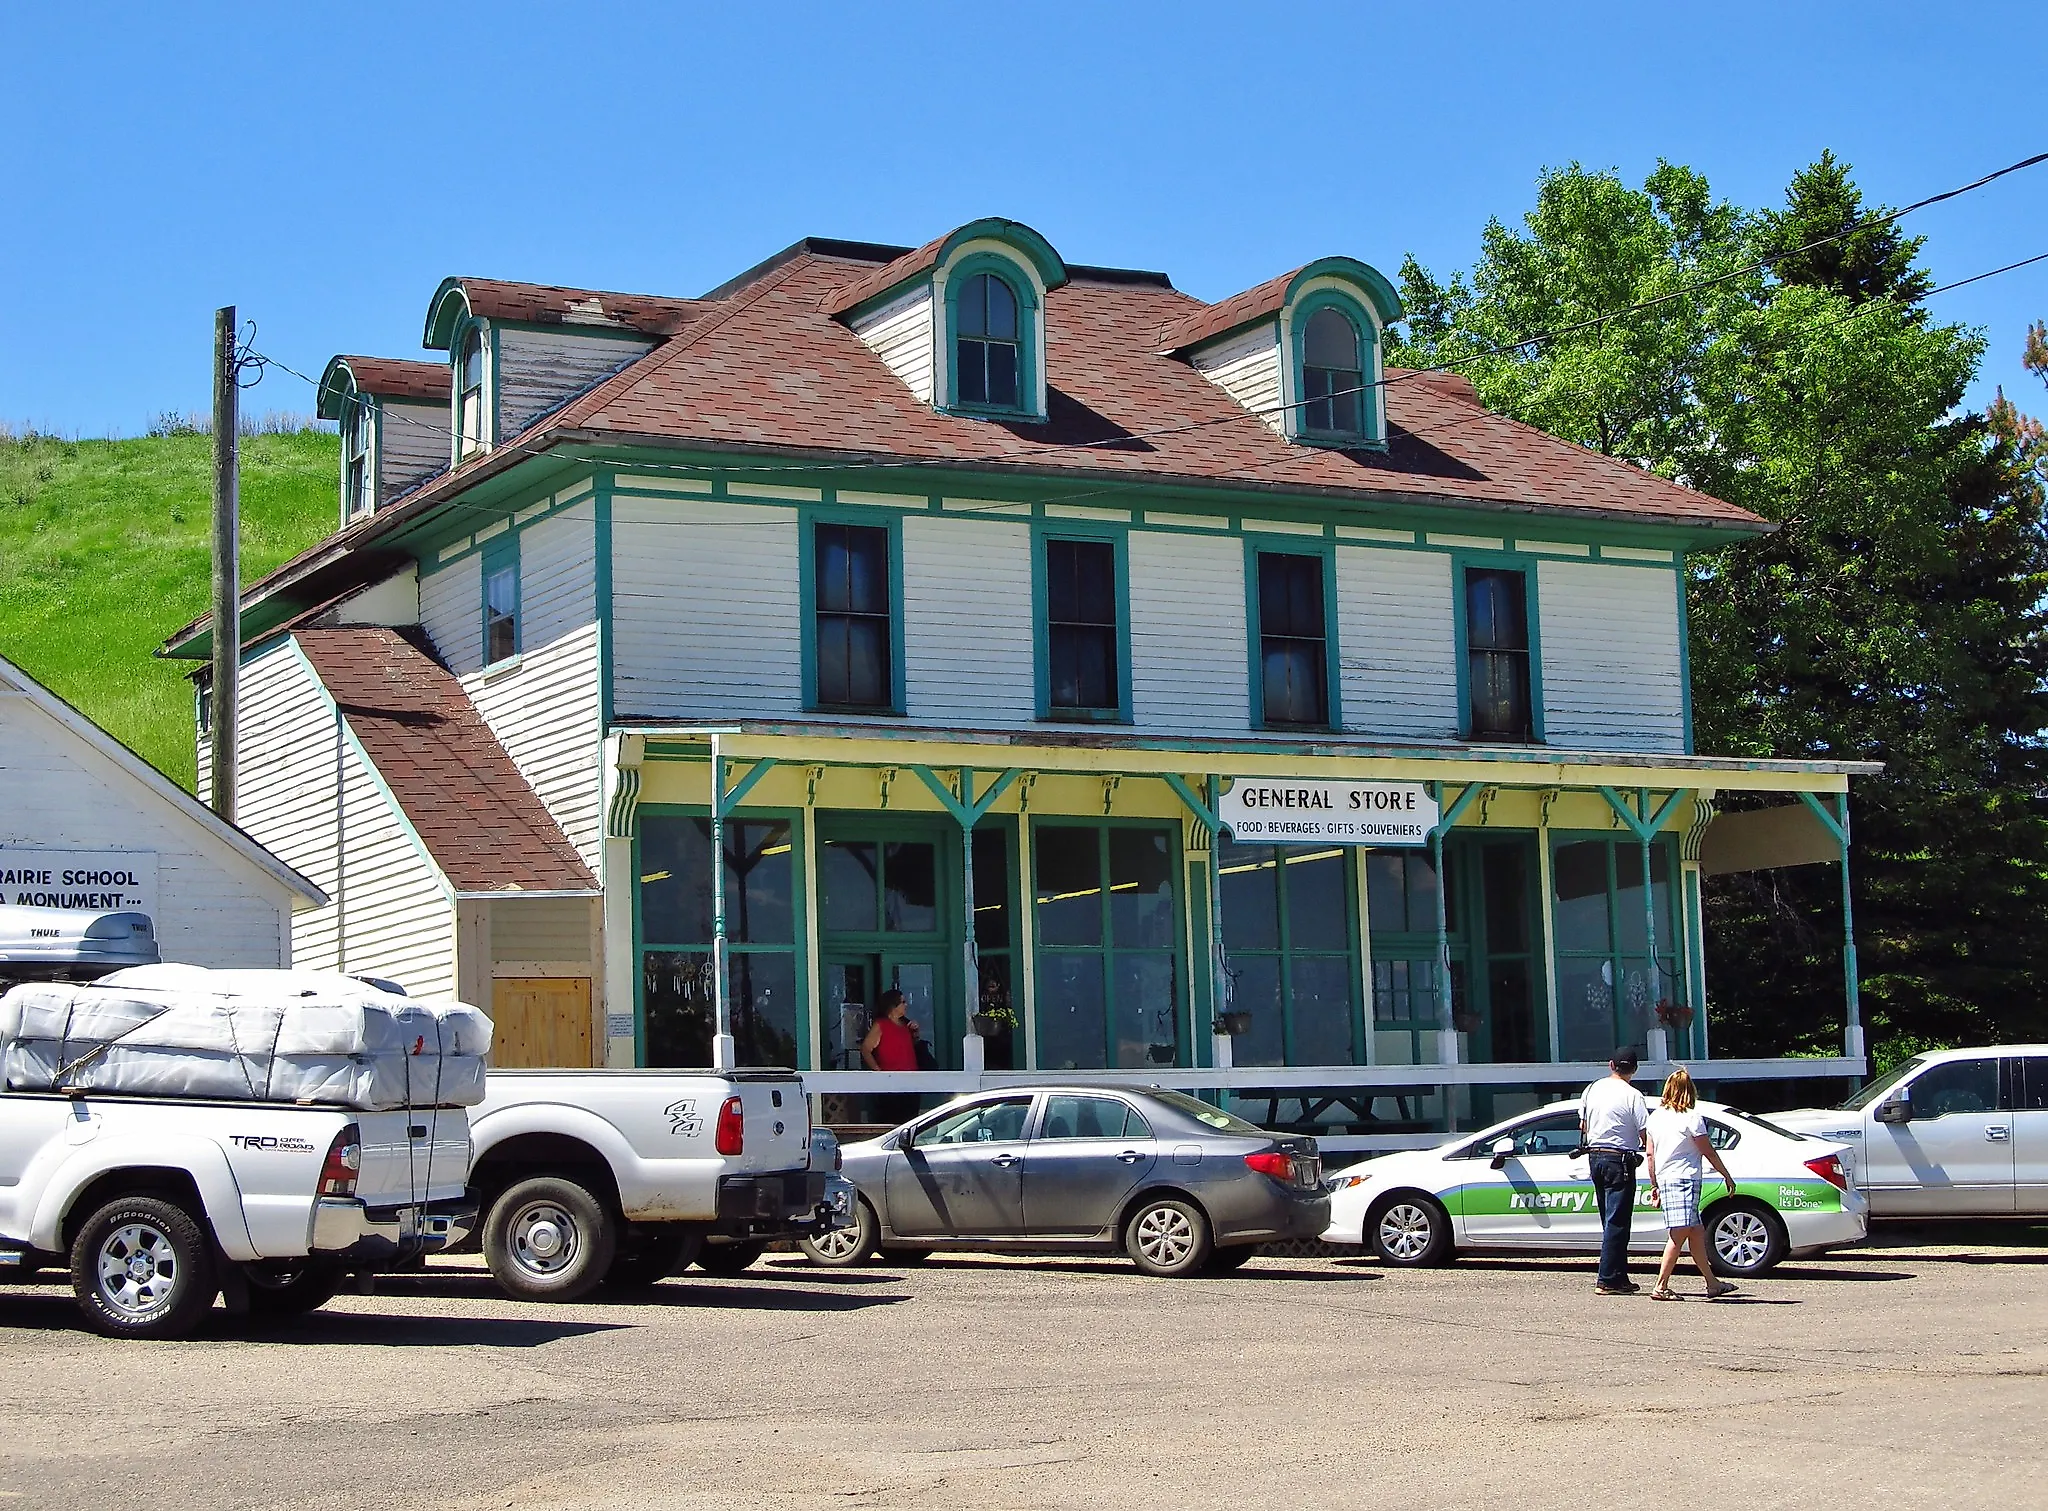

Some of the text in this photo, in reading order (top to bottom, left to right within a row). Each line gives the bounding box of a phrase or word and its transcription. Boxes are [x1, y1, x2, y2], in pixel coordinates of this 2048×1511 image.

[1241, 788, 1416, 810] GENERAL STORE
[1237, 822, 1422, 836] FOOD BEVERAGES GIFTS SOUVENIERS
[62, 870, 139, 885] SCHOOL
[31, 929, 60, 937] THULE
[229, 1135, 278, 1150] TRD
[1510, 1191, 1589, 1212] merry
[110, 1211, 172, 1233] BFGoodrich
[102, 1307, 130, 1324] Trail
[130, 1304, 171, 1324] Rugged
